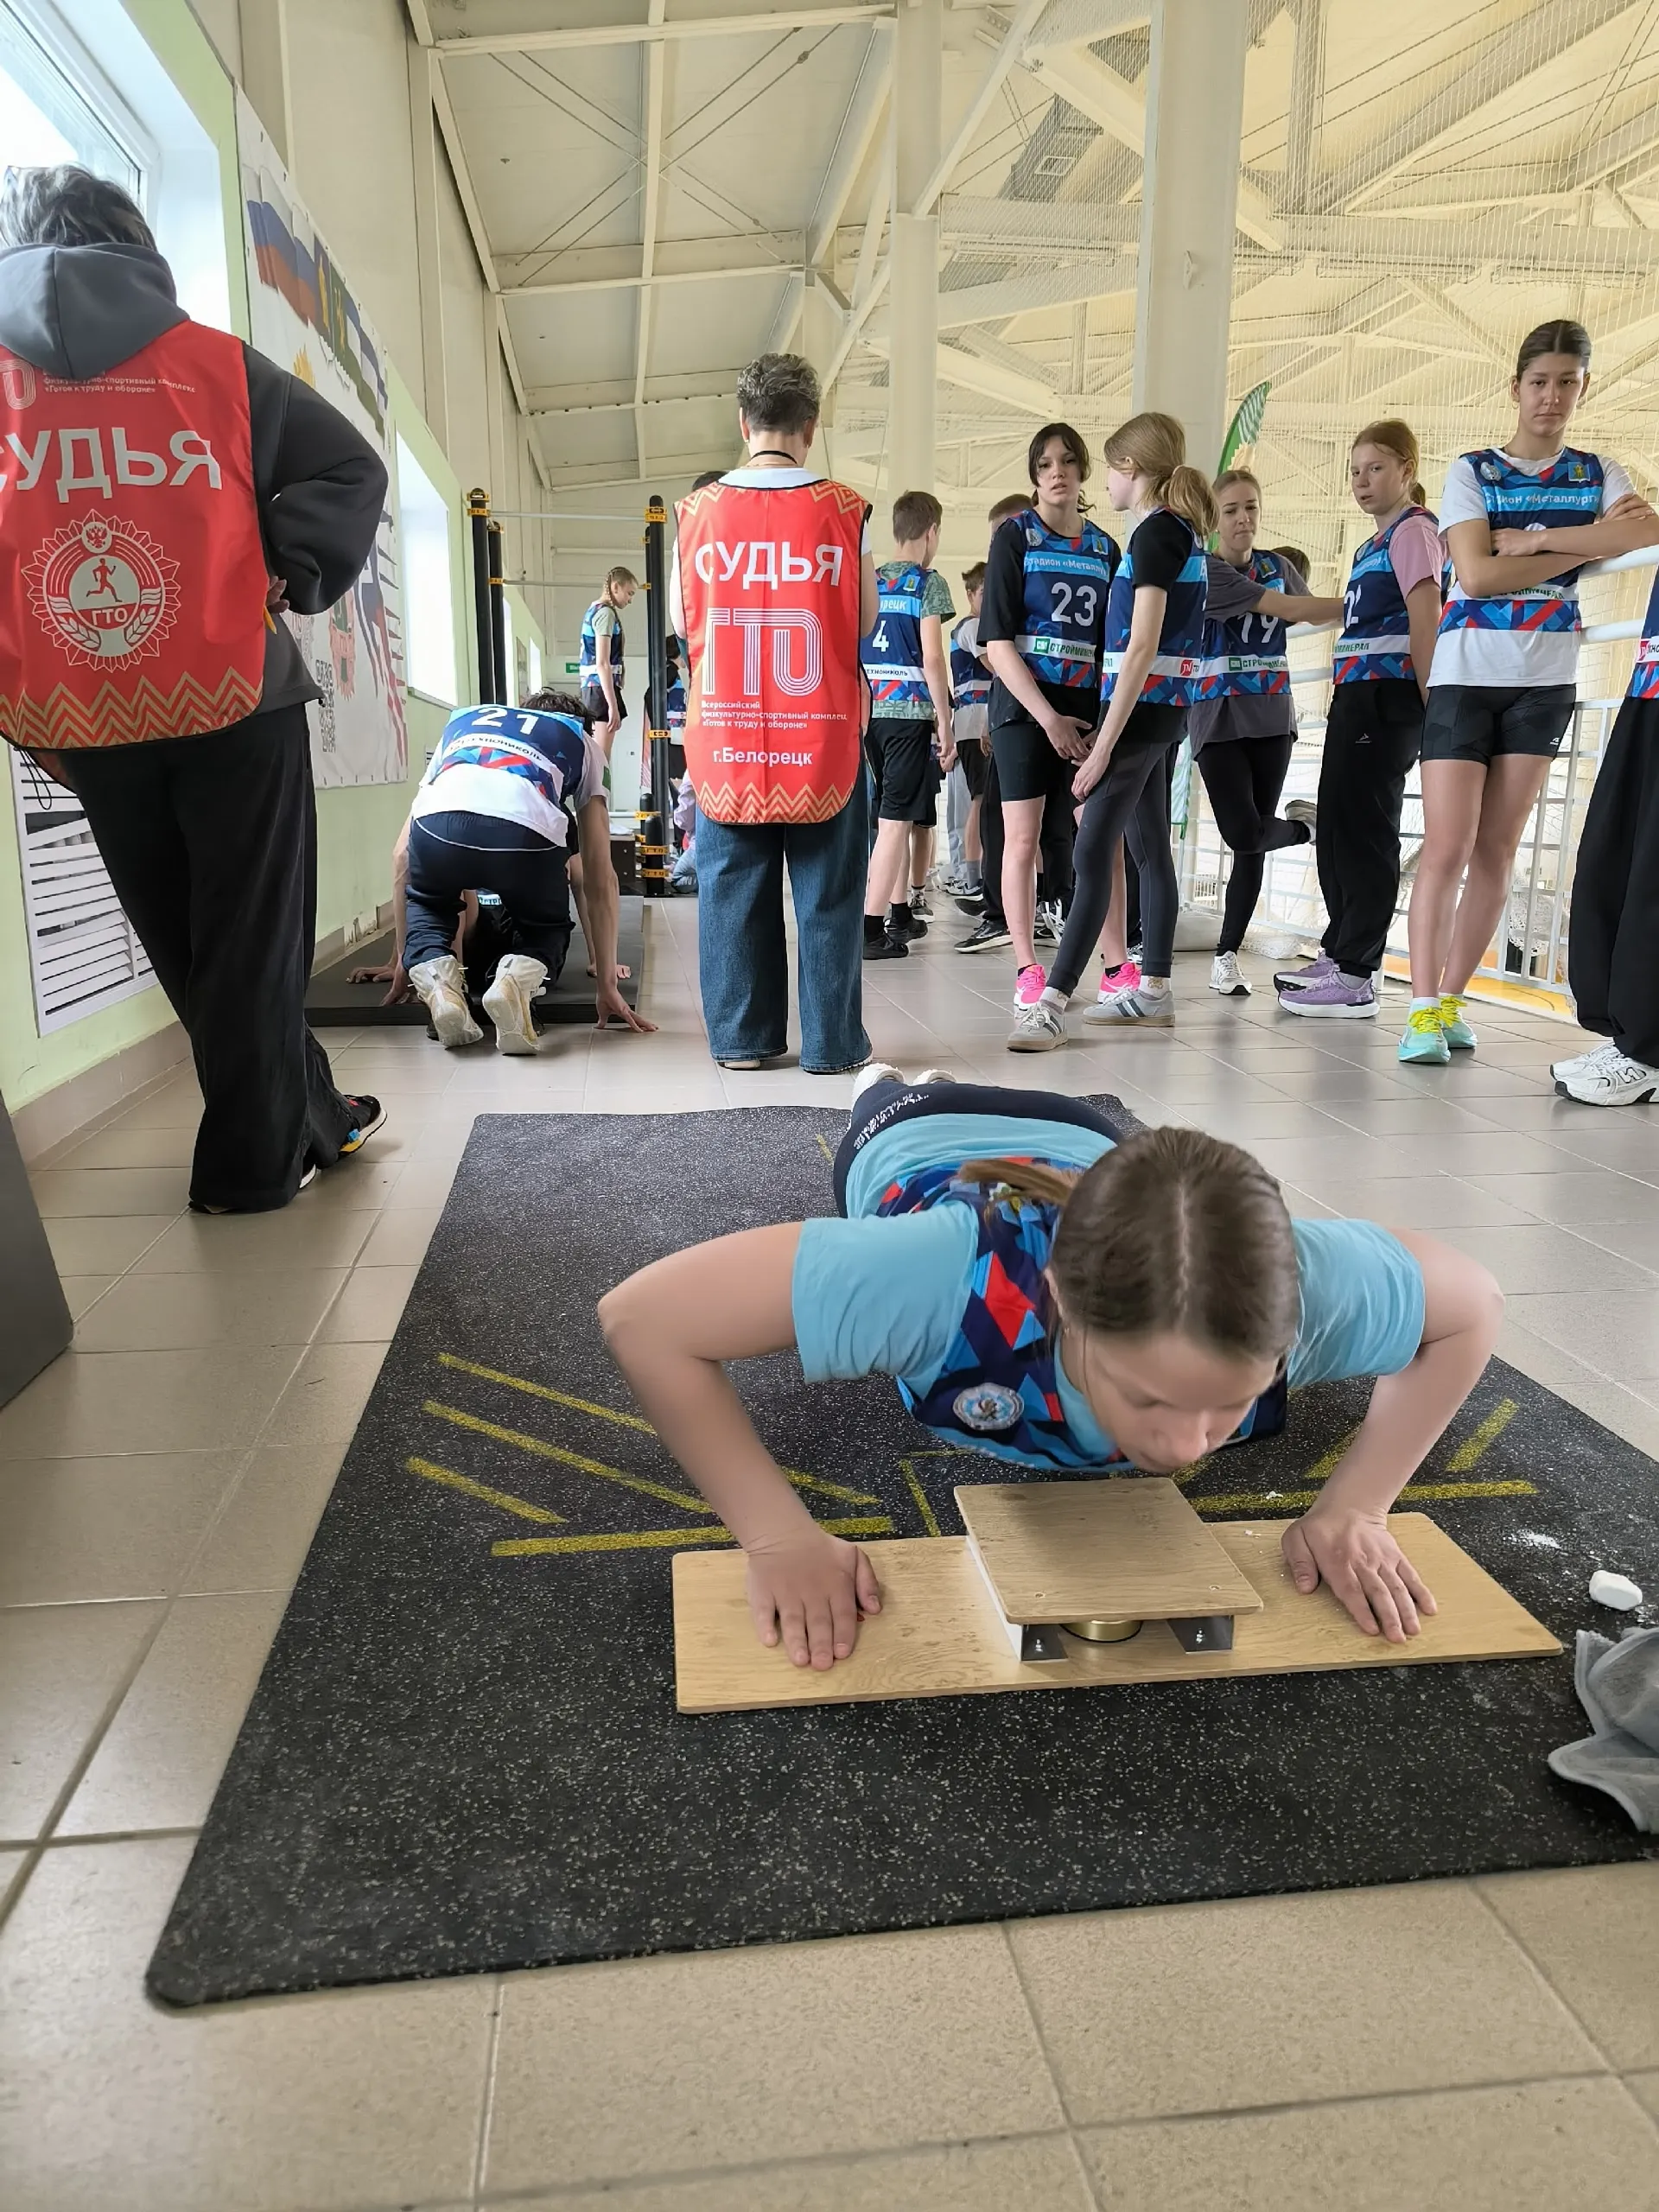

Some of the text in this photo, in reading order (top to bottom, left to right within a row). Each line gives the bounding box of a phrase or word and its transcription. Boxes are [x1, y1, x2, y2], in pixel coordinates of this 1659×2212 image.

[0, 427, 222, 504] УДЬЯ
[695, 541, 843, 590] СУДЬЯ
[92, 607, 128, 626] ГТО
[1051, 582, 1097, 626] 23
[873, 620, 890, 652] 4
[702, 607, 823, 696] ГТО
[701, 701, 761, 710] Всероссийский
[701, 710, 809, 721] физкультурно-спортивный
[471, 707, 539, 734] 21
[734, 721, 759, 729] труду
[768, 721, 808, 730] обороне»
[713, 747, 813, 767] г.Белорецк
